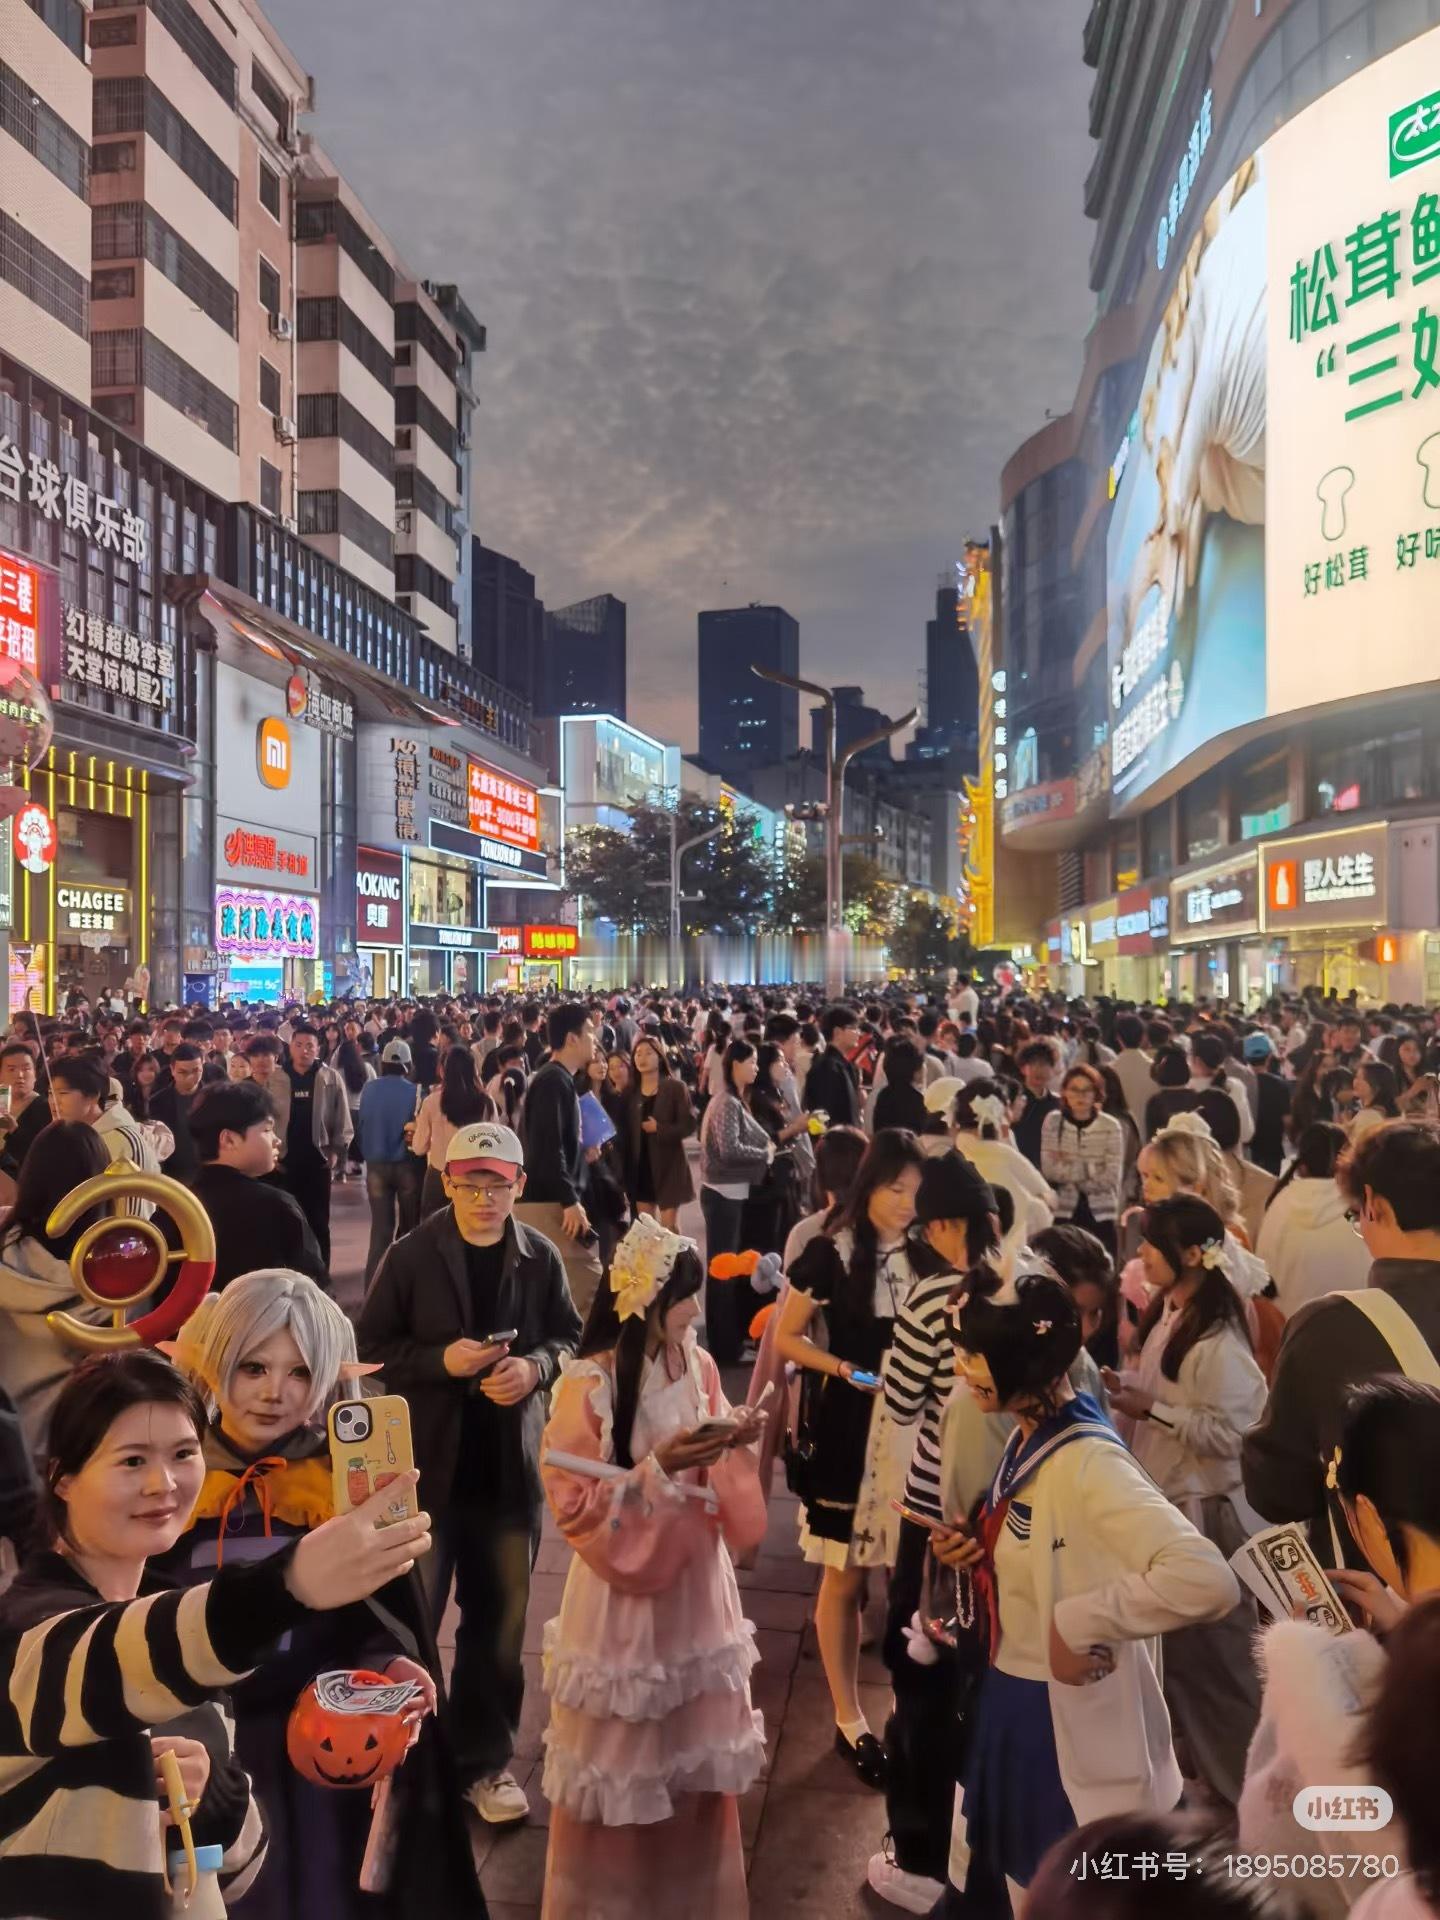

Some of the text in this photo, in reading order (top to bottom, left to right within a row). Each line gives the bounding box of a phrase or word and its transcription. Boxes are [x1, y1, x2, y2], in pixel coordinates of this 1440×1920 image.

[0, 434, 146, 564] 台球俱乐部
[1303, 545, 1368, 598] 好松茸
[356, 871, 400, 900] AOKANG
[1304, 852, 1374, 890] 野人先生
[57, 889, 124, 912] CHAGEE
